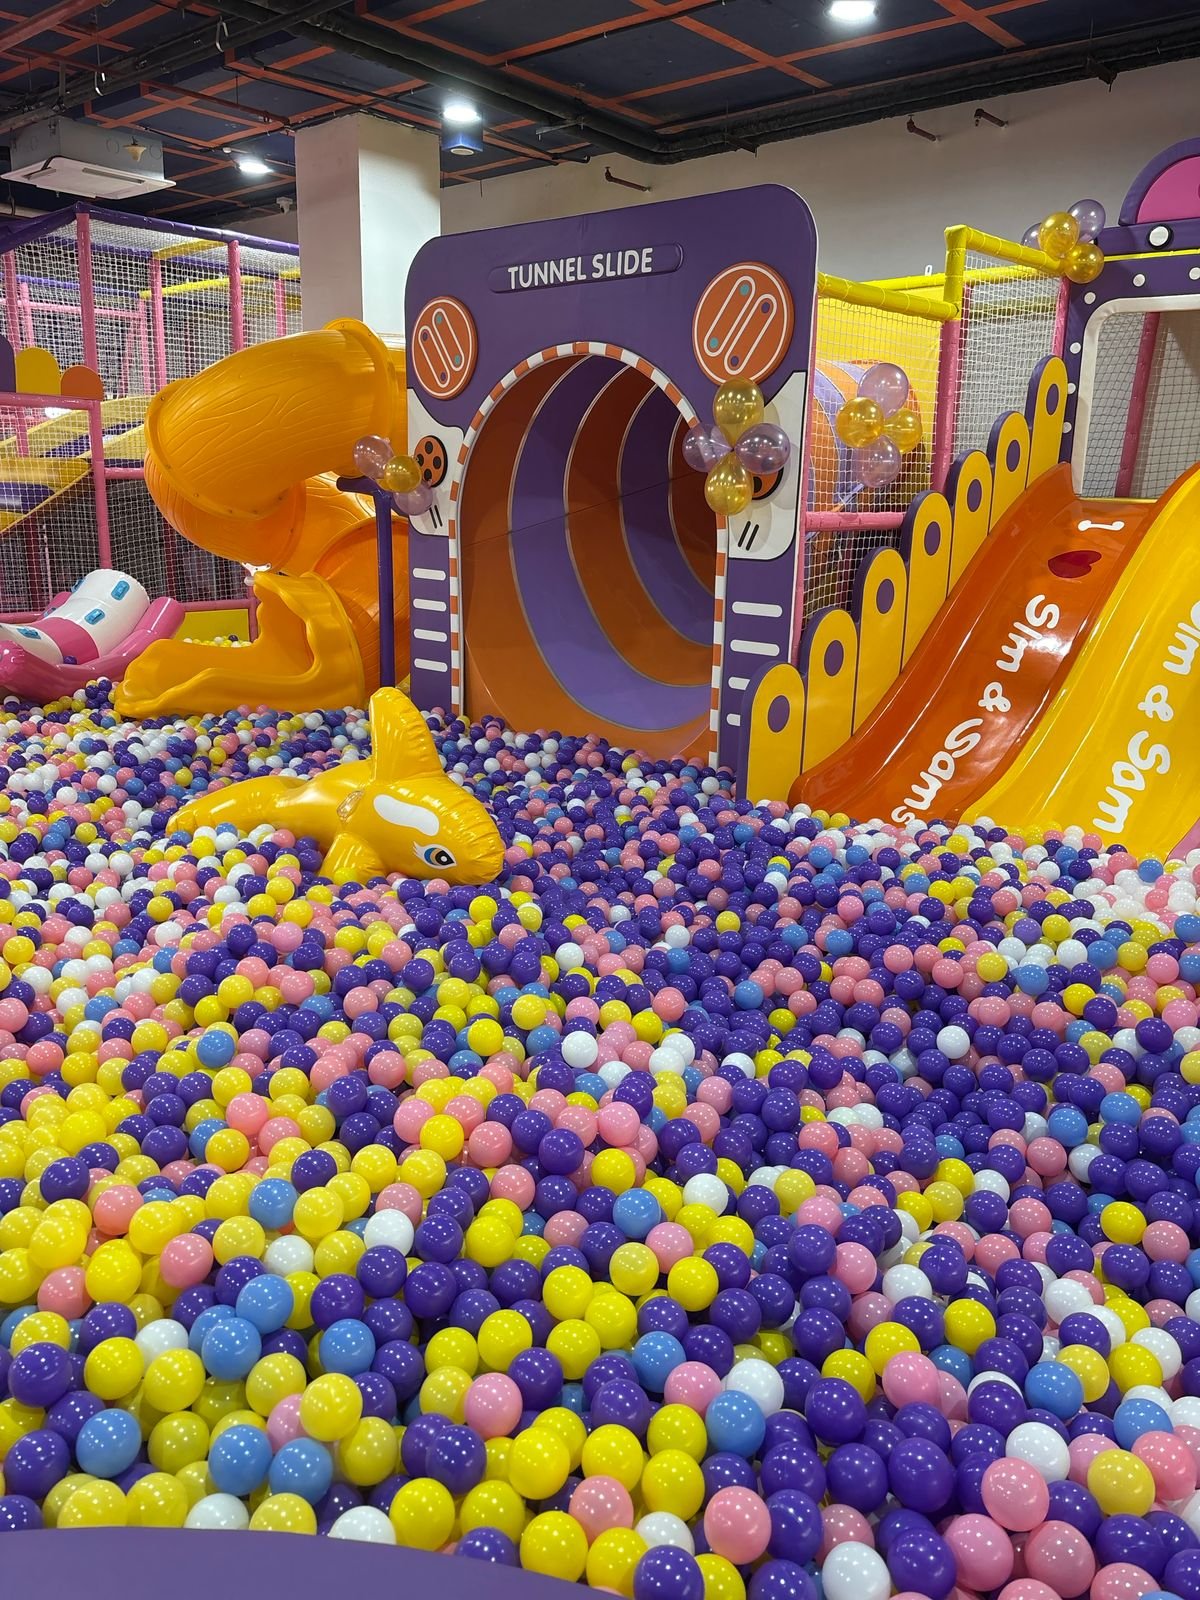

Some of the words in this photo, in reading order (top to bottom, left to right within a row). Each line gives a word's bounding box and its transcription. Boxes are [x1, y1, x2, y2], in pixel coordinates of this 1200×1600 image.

[507, 256, 587, 290] TUNNEL
[591, 247, 653, 279] SLIDE
[977, 681, 1012, 713] &
[1137, 684, 1174, 722] &
[1092, 730, 1171, 834] Sam
